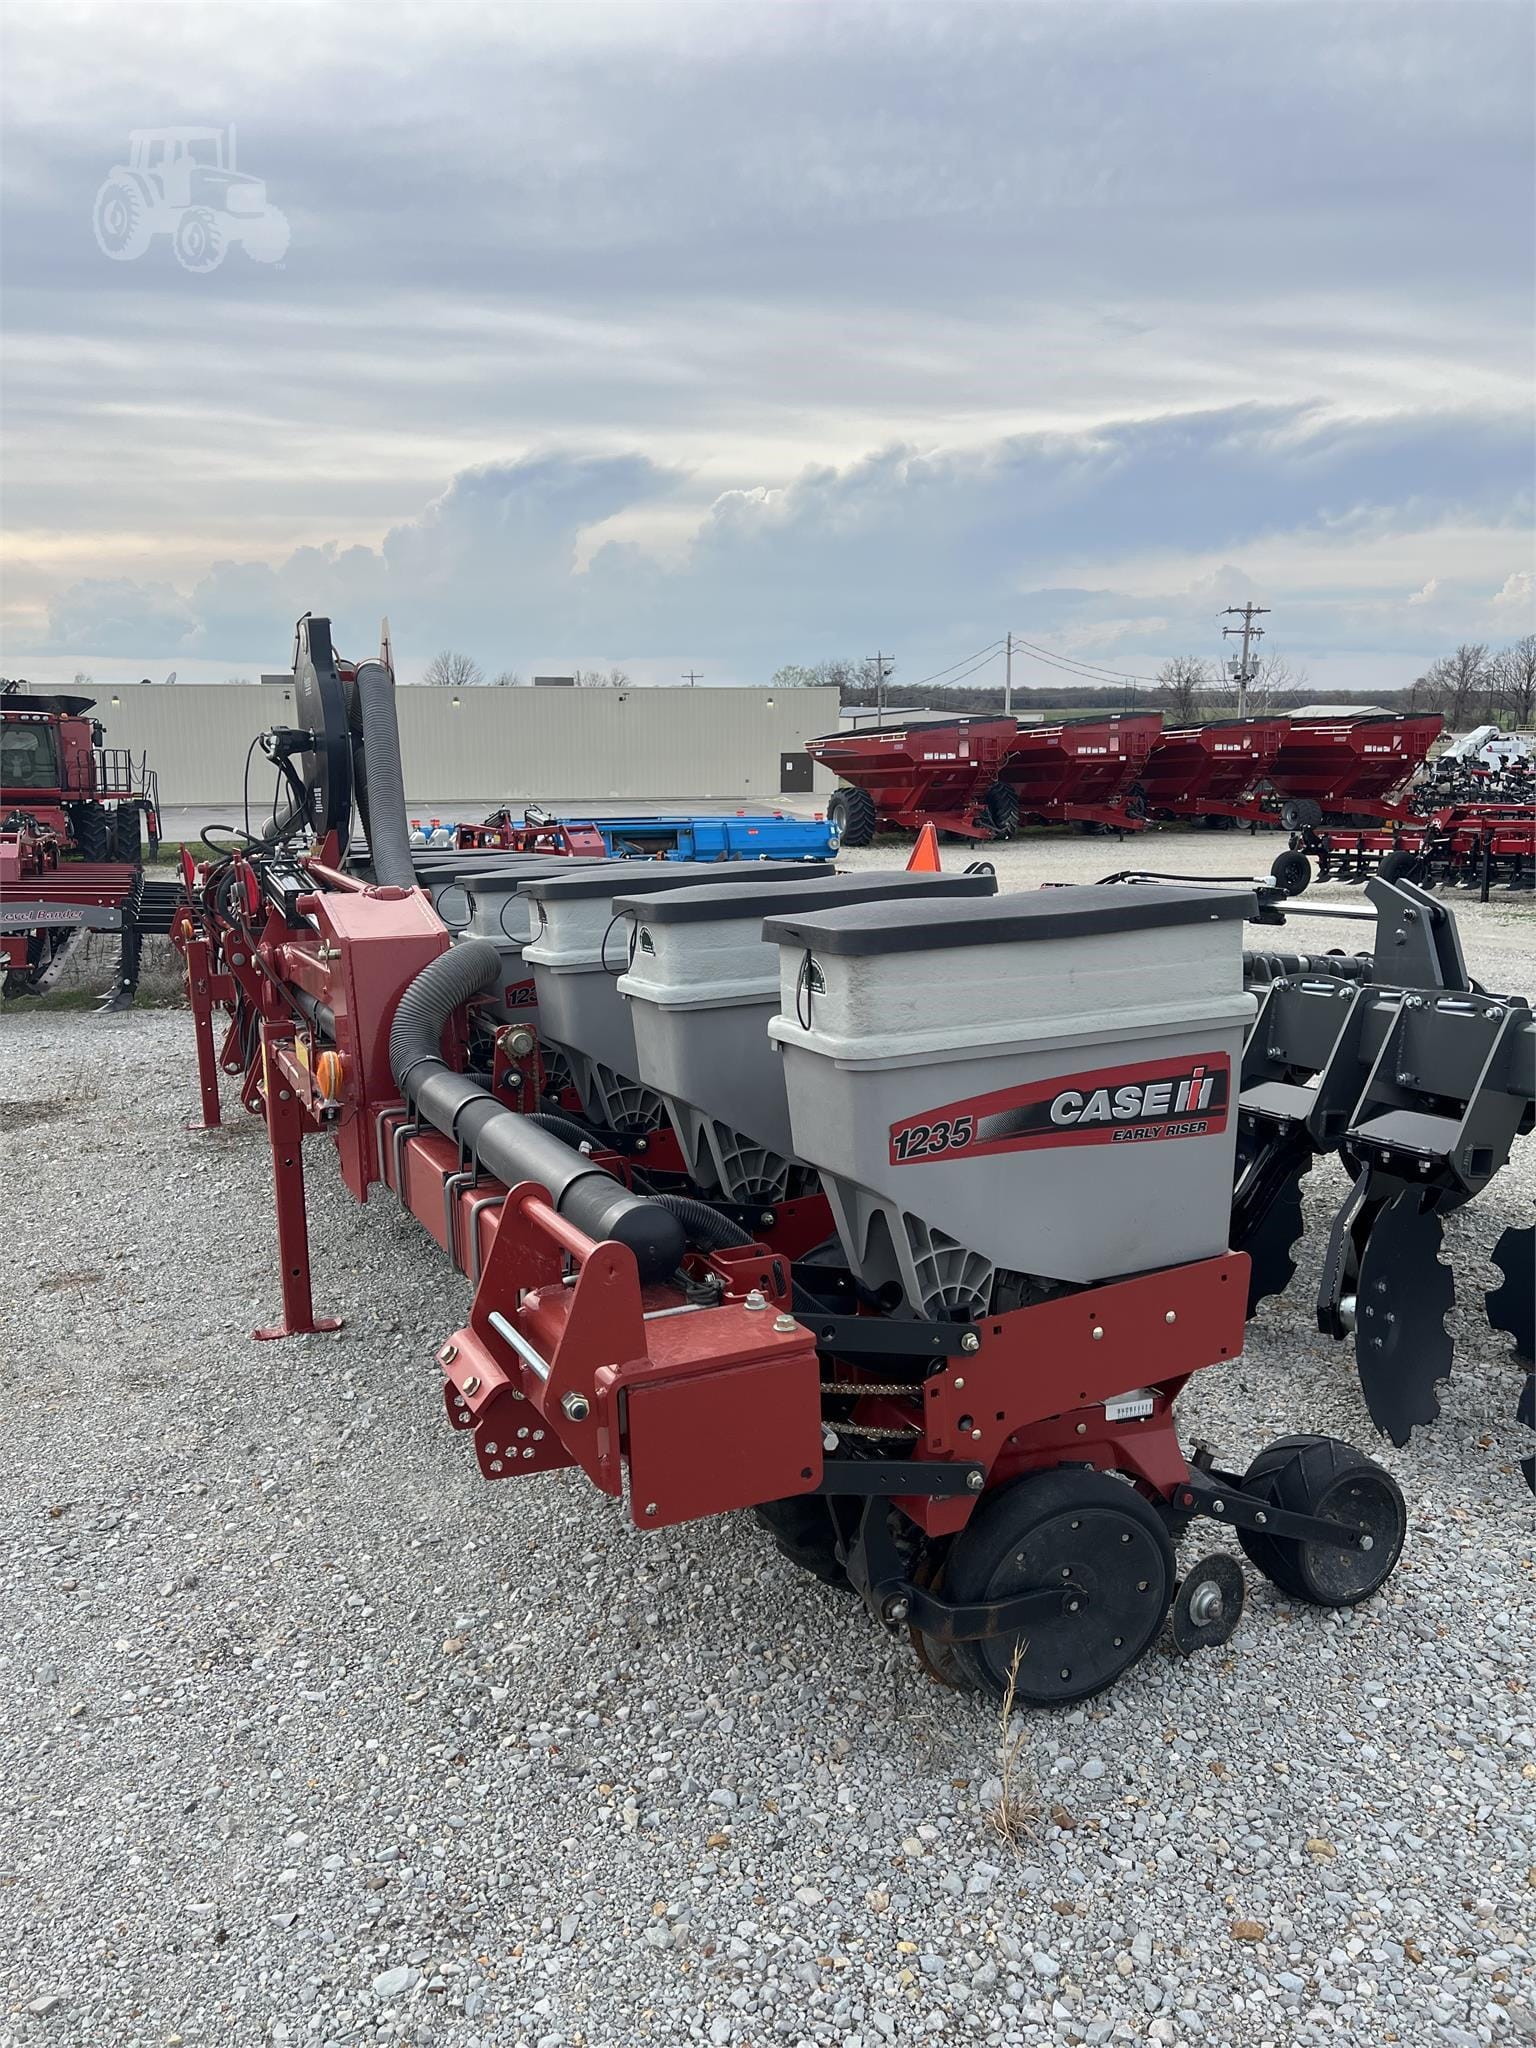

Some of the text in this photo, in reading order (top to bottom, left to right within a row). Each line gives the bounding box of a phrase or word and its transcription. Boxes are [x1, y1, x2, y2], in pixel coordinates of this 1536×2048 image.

[35, 909, 85, 921] Bander
[1050, 1082, 1173, 1125] CASE
[892, 1114, 974, 1160] 1235
[1111, 1120, 1208, 1142] EARLY RISER
